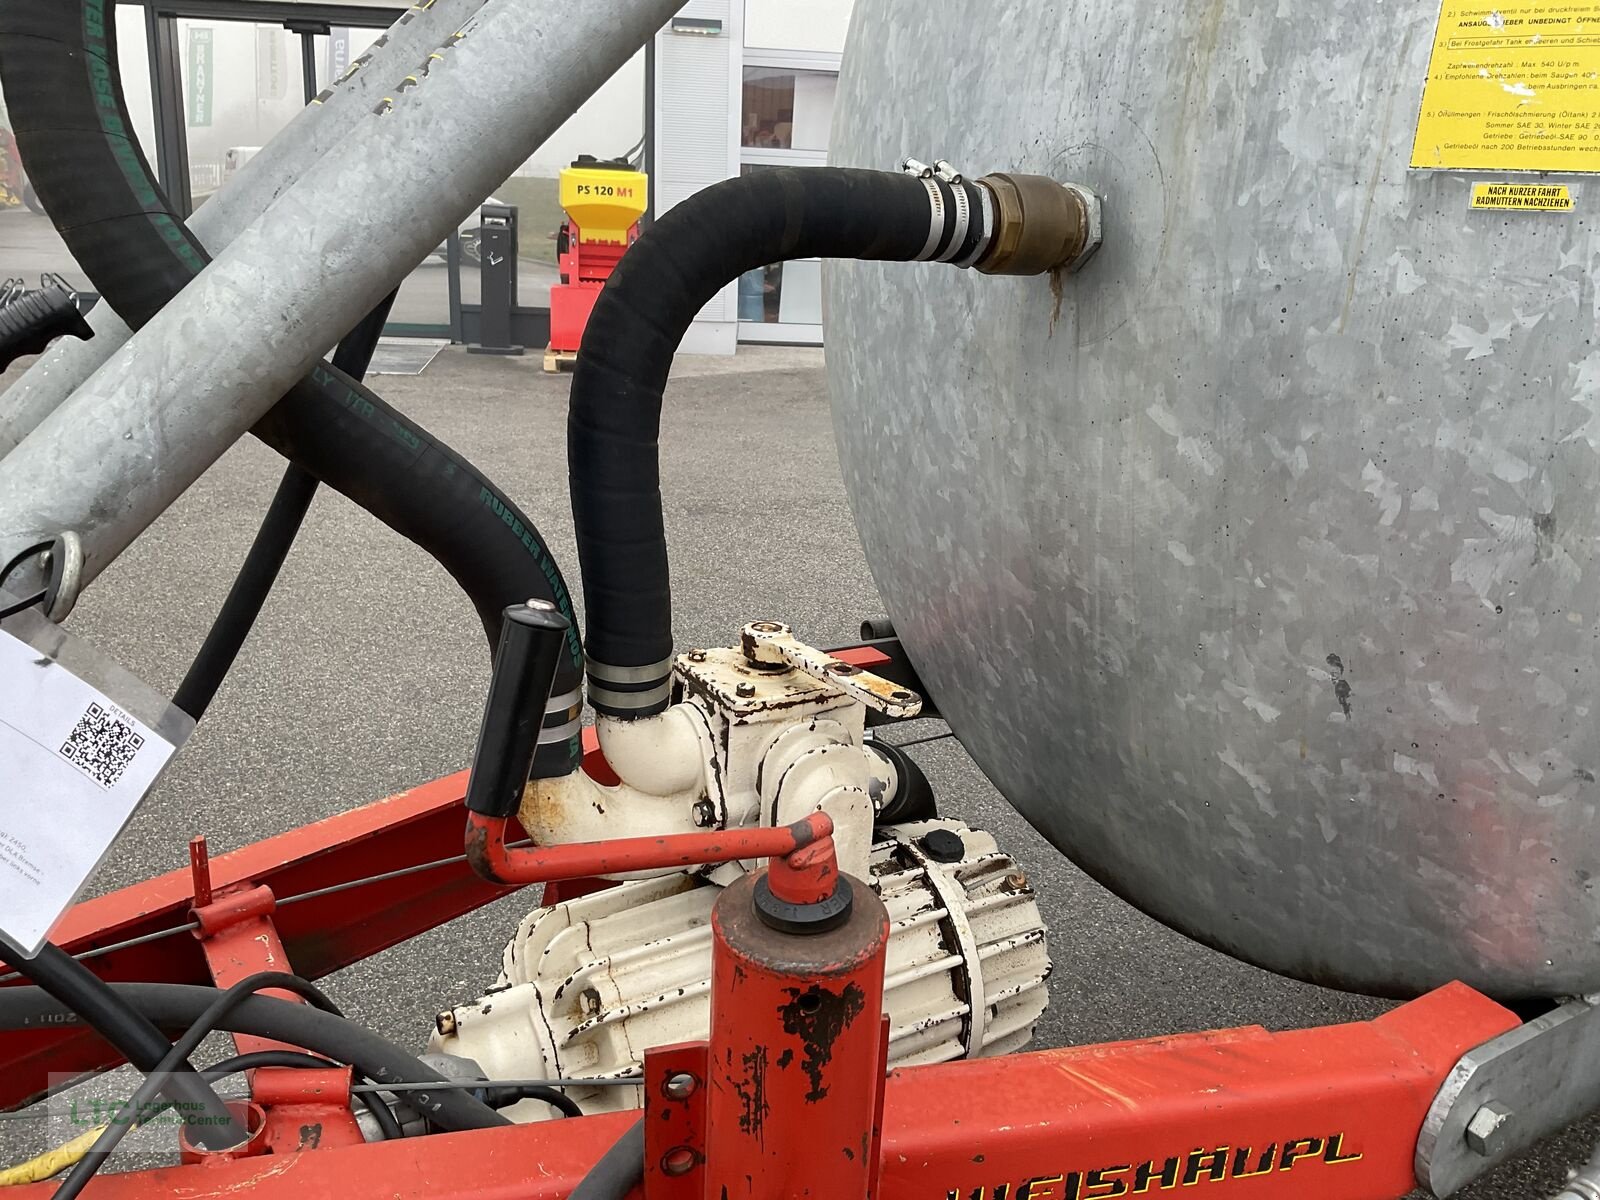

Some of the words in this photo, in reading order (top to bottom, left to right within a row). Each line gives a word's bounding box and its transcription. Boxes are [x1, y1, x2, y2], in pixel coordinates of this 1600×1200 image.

[1460, 8, 1518, 17] Schwimmrventil
[1458, 19, 1524, 27] ANSAUGIEBER
[1528, 17, 1572, 25] UNBEDINGT
[1464, 39, 1504, 47] Frostgefahr
[1547, 83, 1588, 91] Ausbringen
[1487, 110, 1556, 118] Frischölschmierung
[1559, 110, 1588, 119] (Öltank)
[1444, 142, 1479, 150] Getriebeöl
[1517, 144, 1576, 152] Betriebsstunden
[577, 185, 590, 195] PS
[594, 186, 614, 197] 120
[616, 187, 633, 198] M1
[1488, 186, 1507, 195] NACH
[1509, 187, 1536, 197] KURZER
[1538, 187, 1561, 197] FAHRT
[1475, 196, 1522, 206] RADMUTTERN
[1524, 197, 1570, 208] NACHZIEHEN
[478, 484, 542, 560] RUBBER
[109, 704, 136, 727] DETAILS
